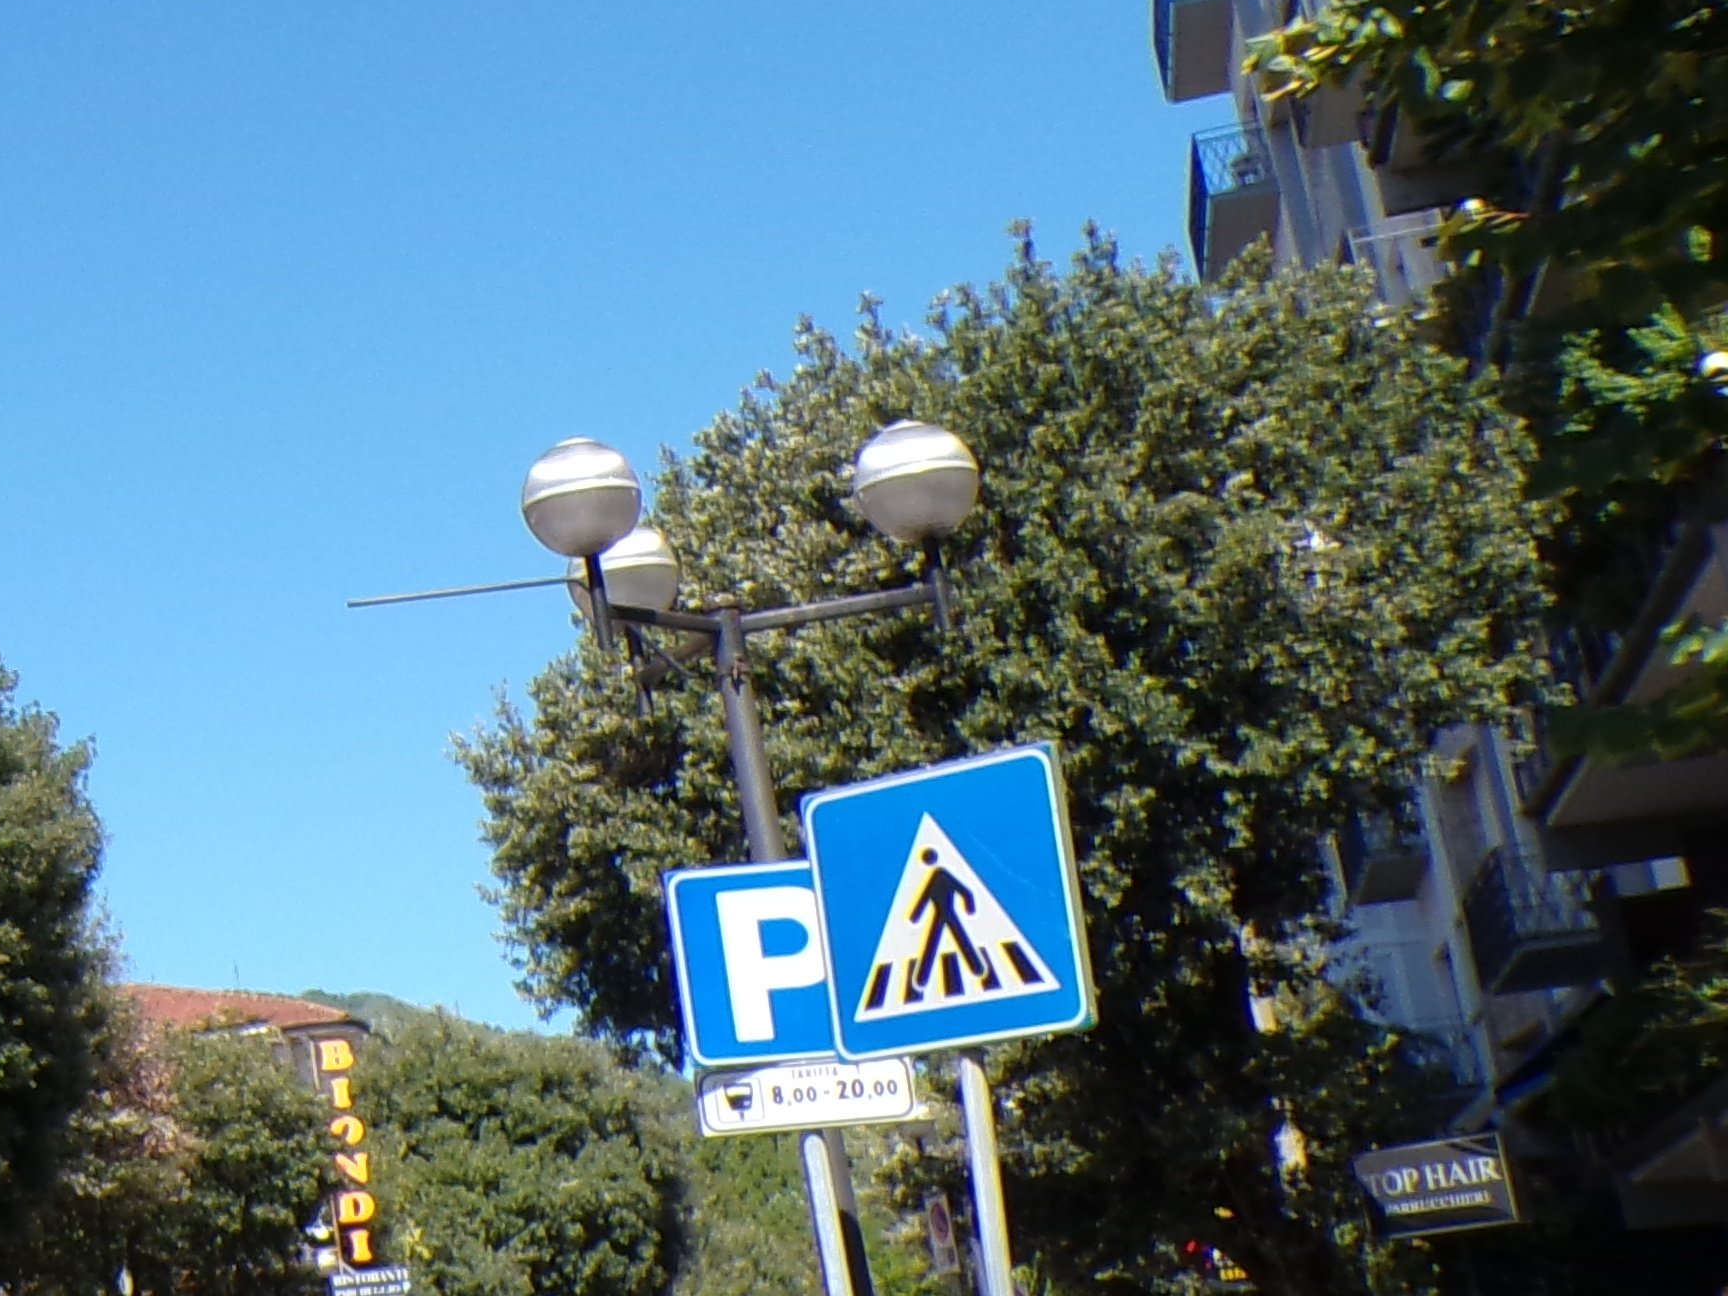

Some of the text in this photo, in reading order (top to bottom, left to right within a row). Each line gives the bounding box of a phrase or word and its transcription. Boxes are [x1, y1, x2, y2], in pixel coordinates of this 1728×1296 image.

[715, 886, 826, 1042] P
[1366, 1156, 1502, 1196] TOP HAIR
